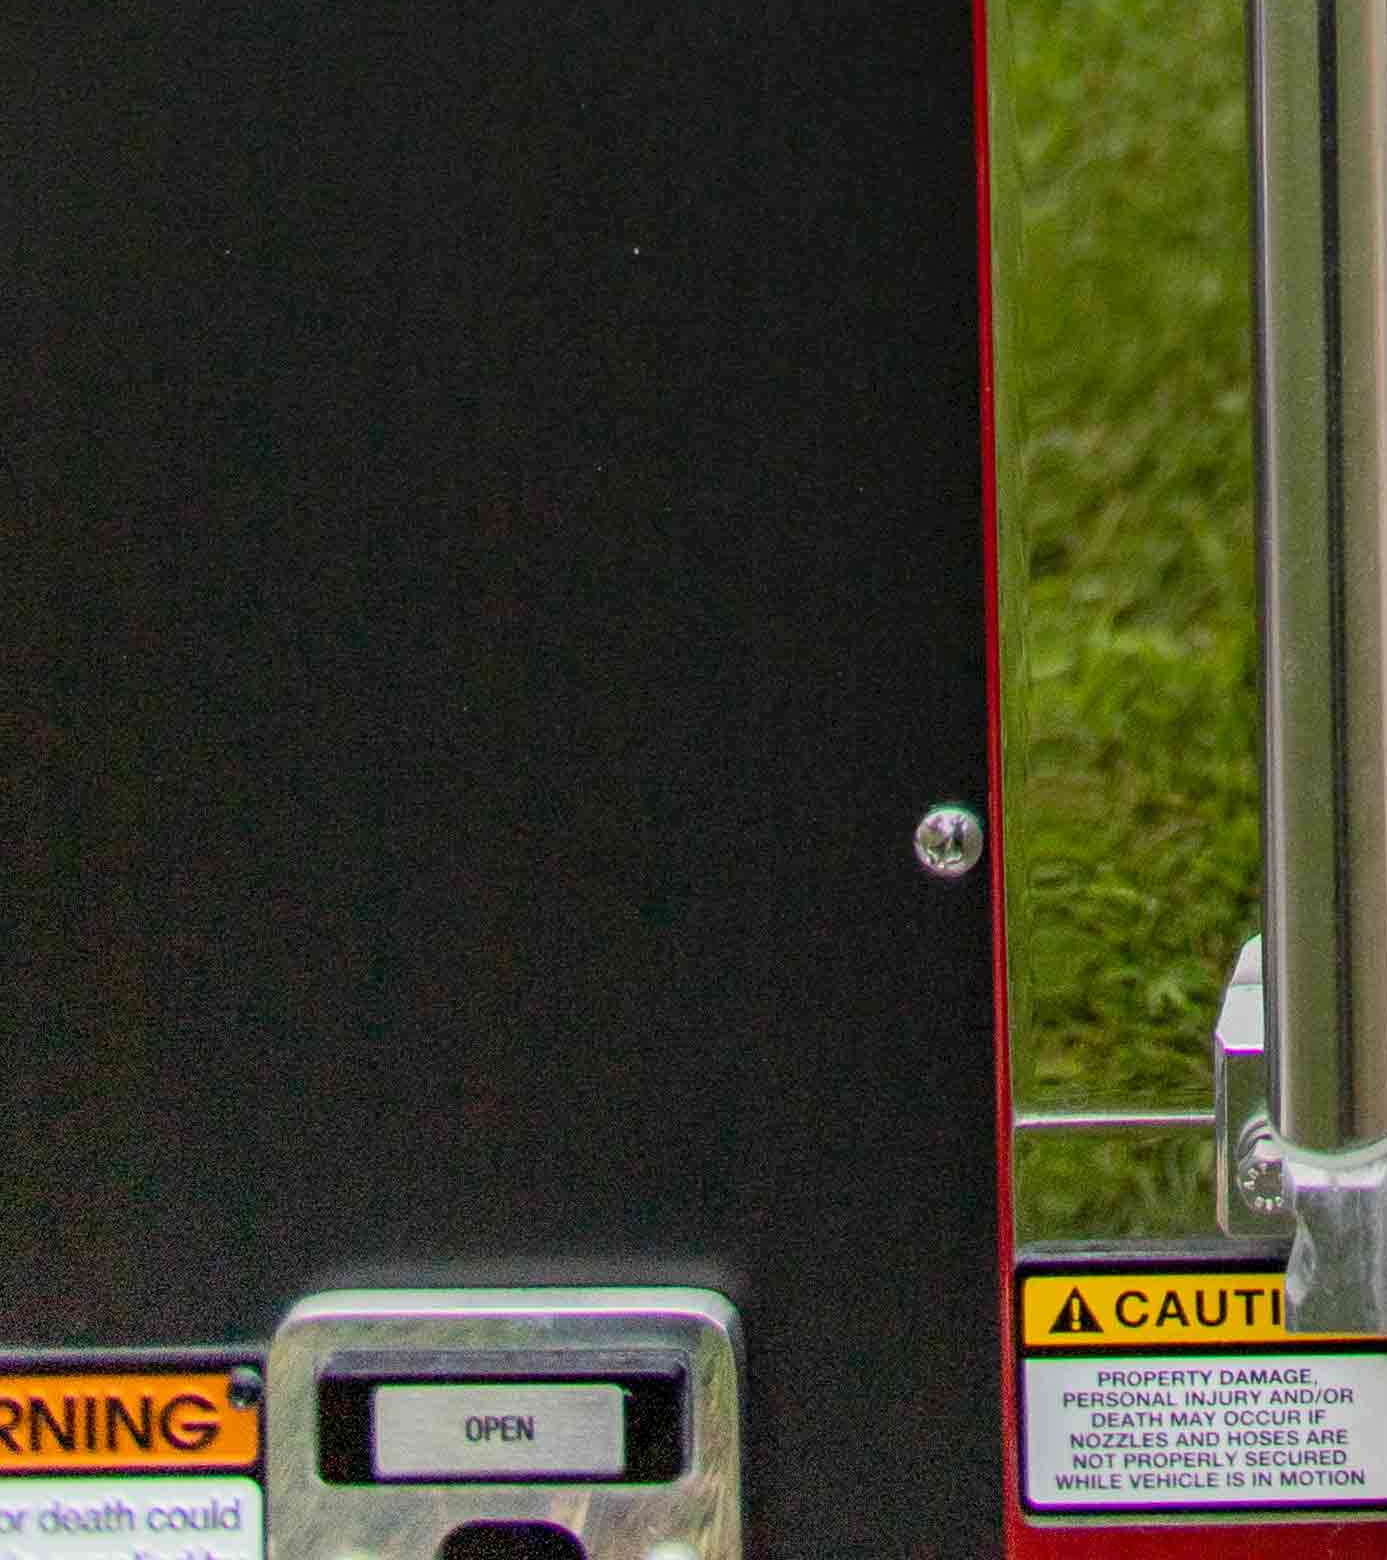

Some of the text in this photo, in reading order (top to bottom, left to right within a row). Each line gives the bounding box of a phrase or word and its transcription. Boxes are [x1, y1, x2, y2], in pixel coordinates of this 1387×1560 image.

[1097, 1369, 1318, 1387] PROPERTY DAMAGE,
[1063, 1388, 1353, 1408] PERSONAL INJURY AND/OR
[464, 1415, 536, 1441] OPEN
[1091, 1409, 1327, 1428] DEATH MAY OCCUR IF
[1070, 1429, 1349, 1448] NOZZLES AND HOSES ARE
[1073, 1450, 1347, 1469] NOT PROPERLY SECURED
[1056, 1469, 1365, 1490] WHILE VEHICLE IS IN MOTION
[40, 1496, 135, 1532] death
[147, 1496, 241, 1532] could
